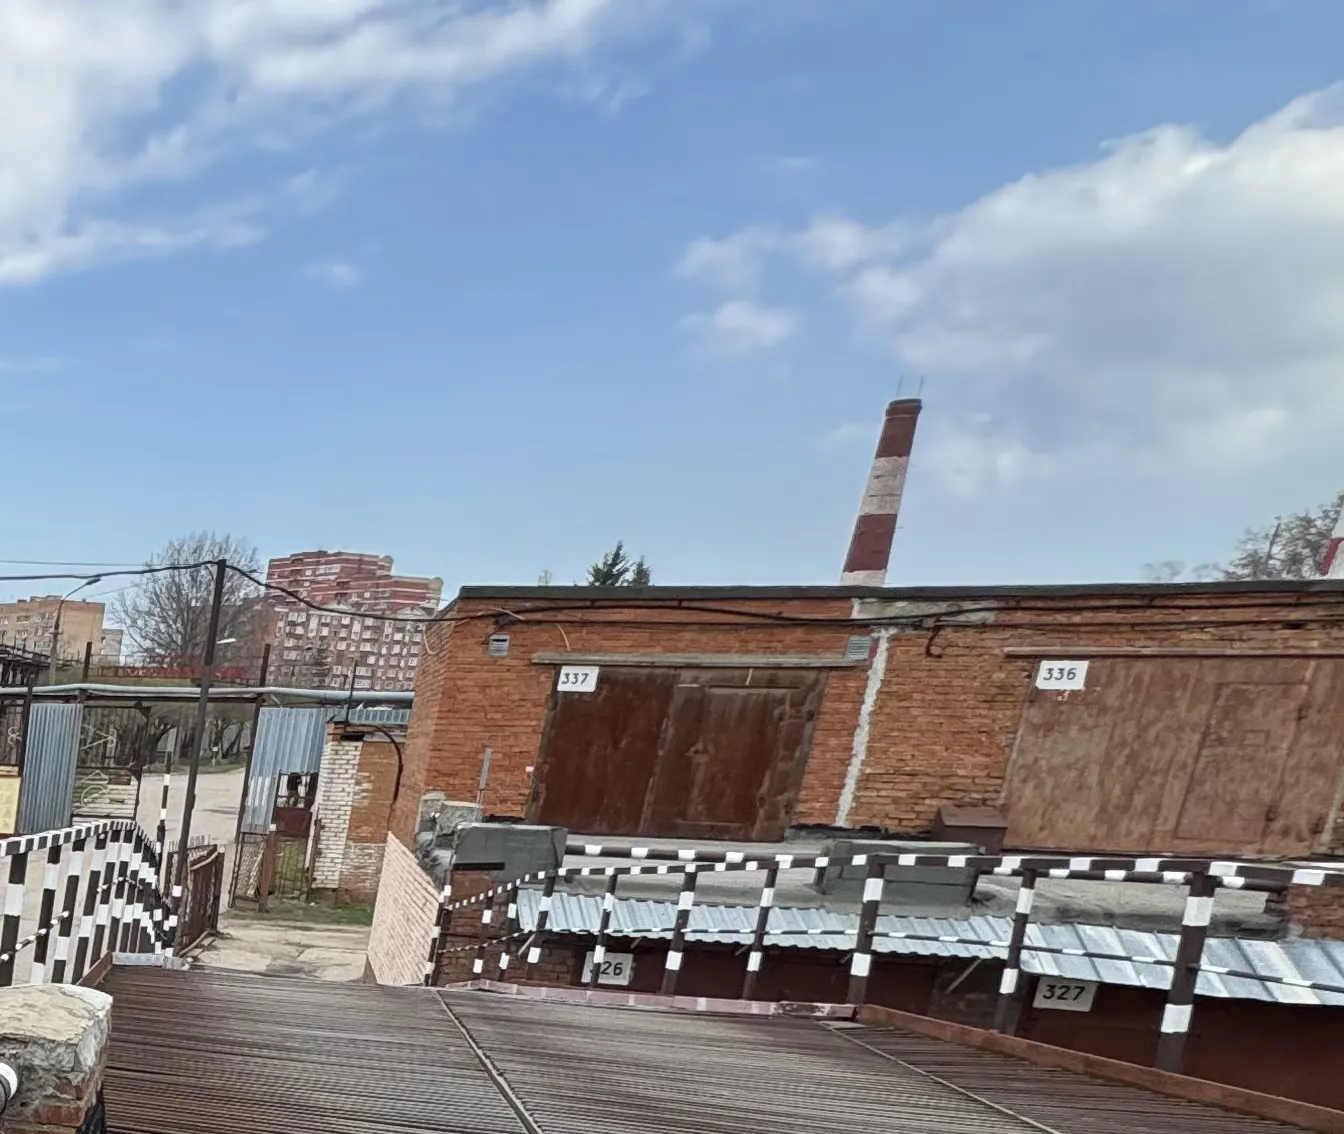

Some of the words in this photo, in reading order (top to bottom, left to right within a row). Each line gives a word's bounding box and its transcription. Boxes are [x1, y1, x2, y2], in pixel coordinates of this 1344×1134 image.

[561, 672, 590, 685] 337
[1043, 667, 1077, 681] 336
[1043, 984, 1086, 1001] 327
